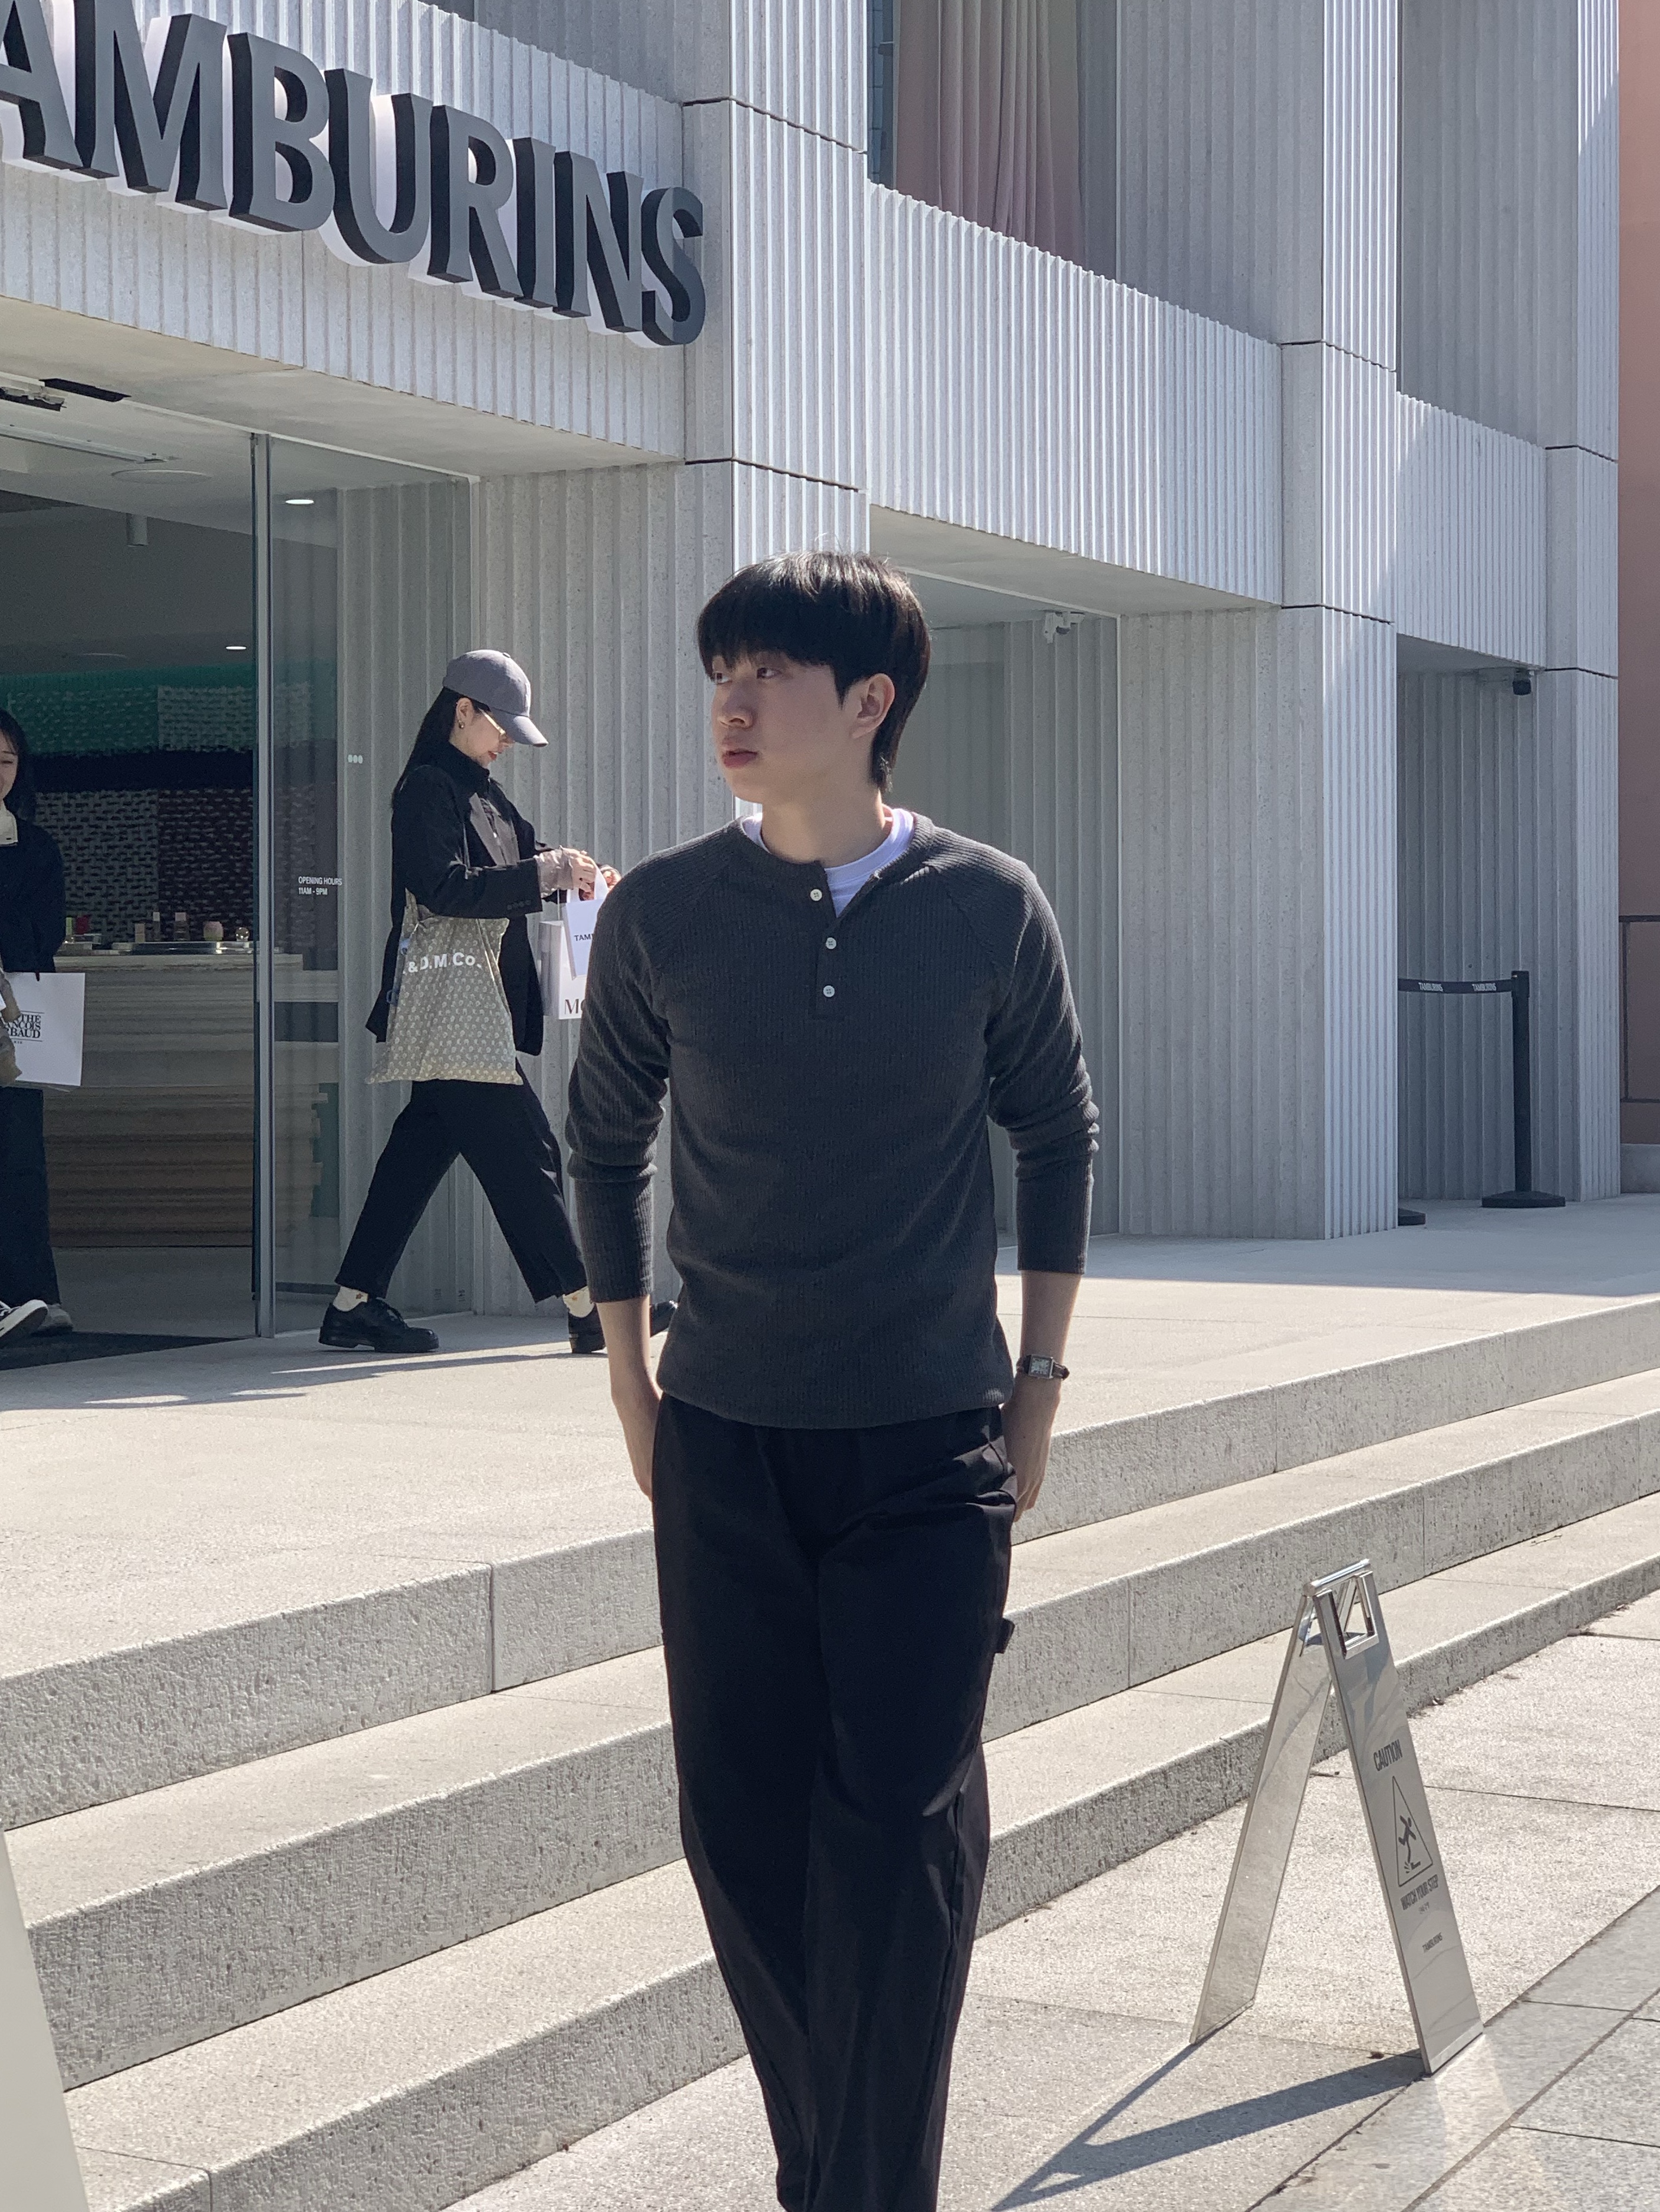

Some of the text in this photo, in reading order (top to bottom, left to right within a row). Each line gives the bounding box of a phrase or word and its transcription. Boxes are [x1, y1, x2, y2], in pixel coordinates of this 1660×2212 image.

[298, 876, 322, 884] OPENING
[574, 933, 593, 942] TAM
[7, 1027, 41, 1038] BAUD
[1374, 1739, 1402, 1771] CAUTION
[1400, 1888, 1418, 1910] WATCH
[1415, 1881, 1429, 1900] YOUR
[1427, 1874, 1438, 1892] STEP
